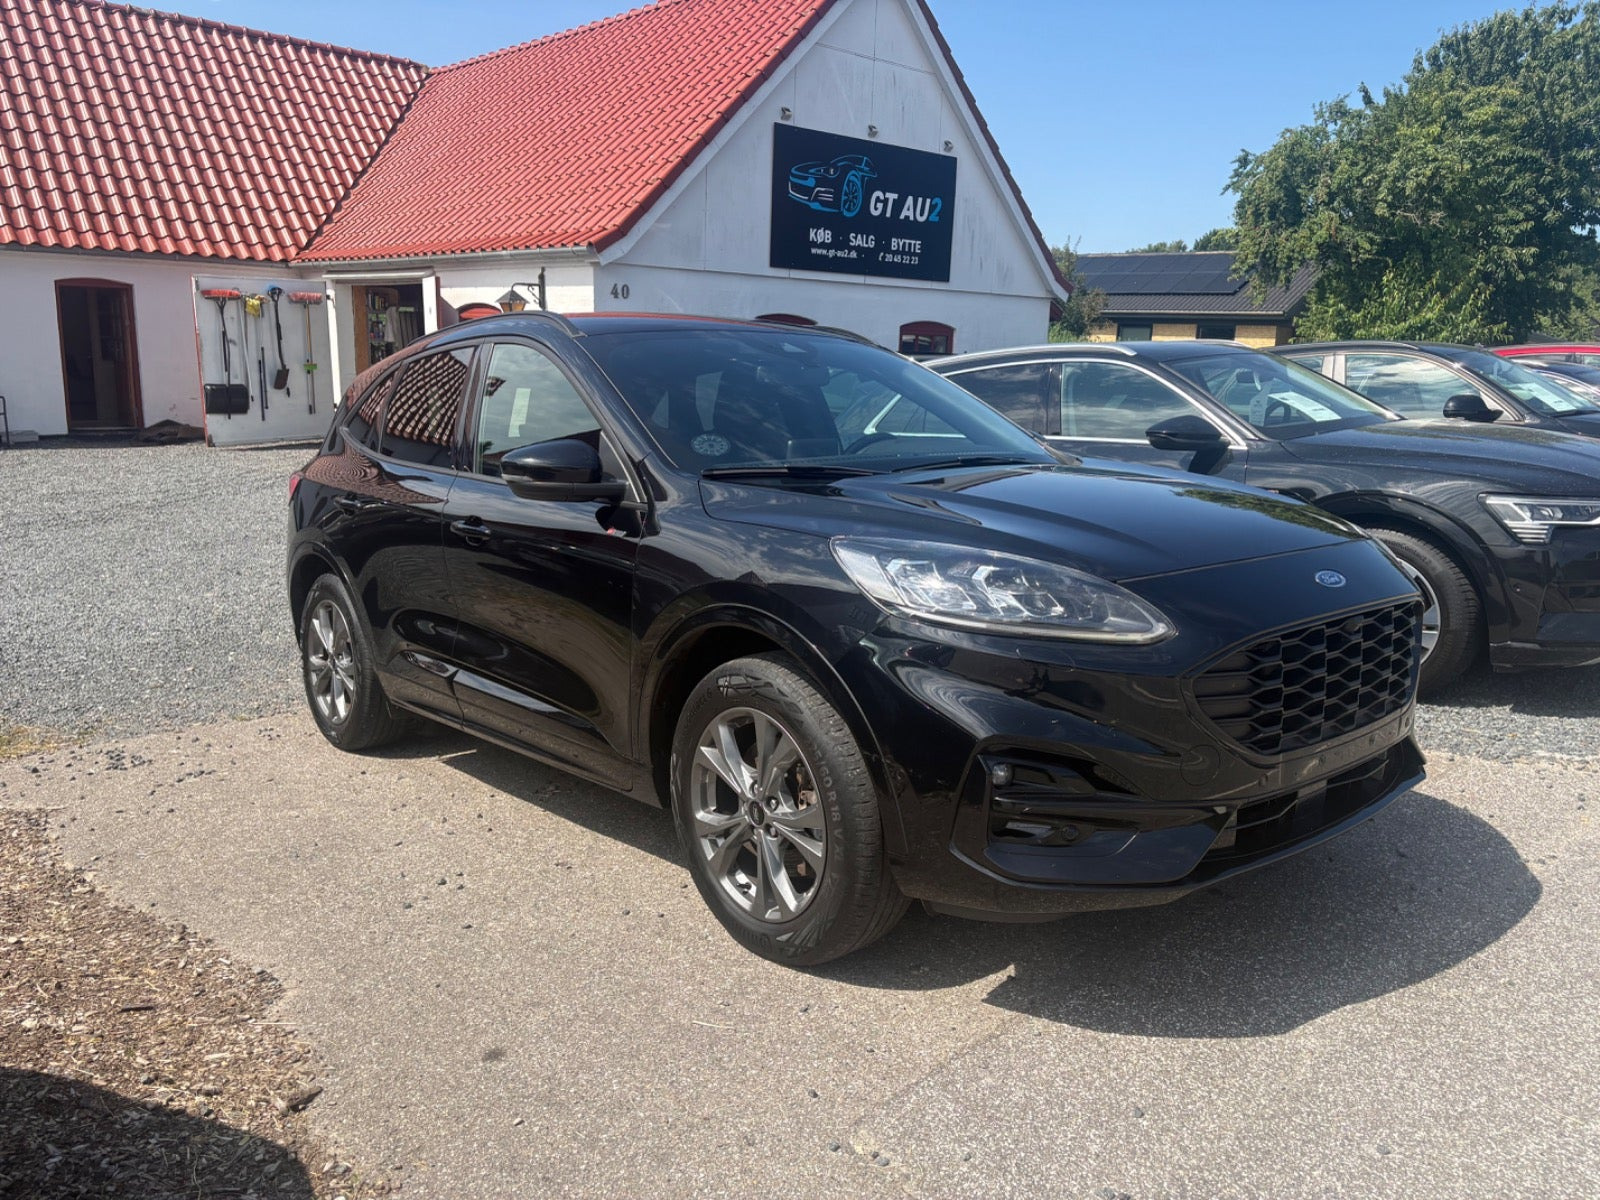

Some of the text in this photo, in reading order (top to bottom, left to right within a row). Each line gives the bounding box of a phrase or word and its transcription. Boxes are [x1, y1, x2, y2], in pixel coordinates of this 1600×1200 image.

[869, 190, 943, 223] GT AU2
[809, 227, 922, 253] KØB SALG BYTTE
[811, 248, 857, 258] www.gt-au2.dk
[610, 282, 630, 300] 40
